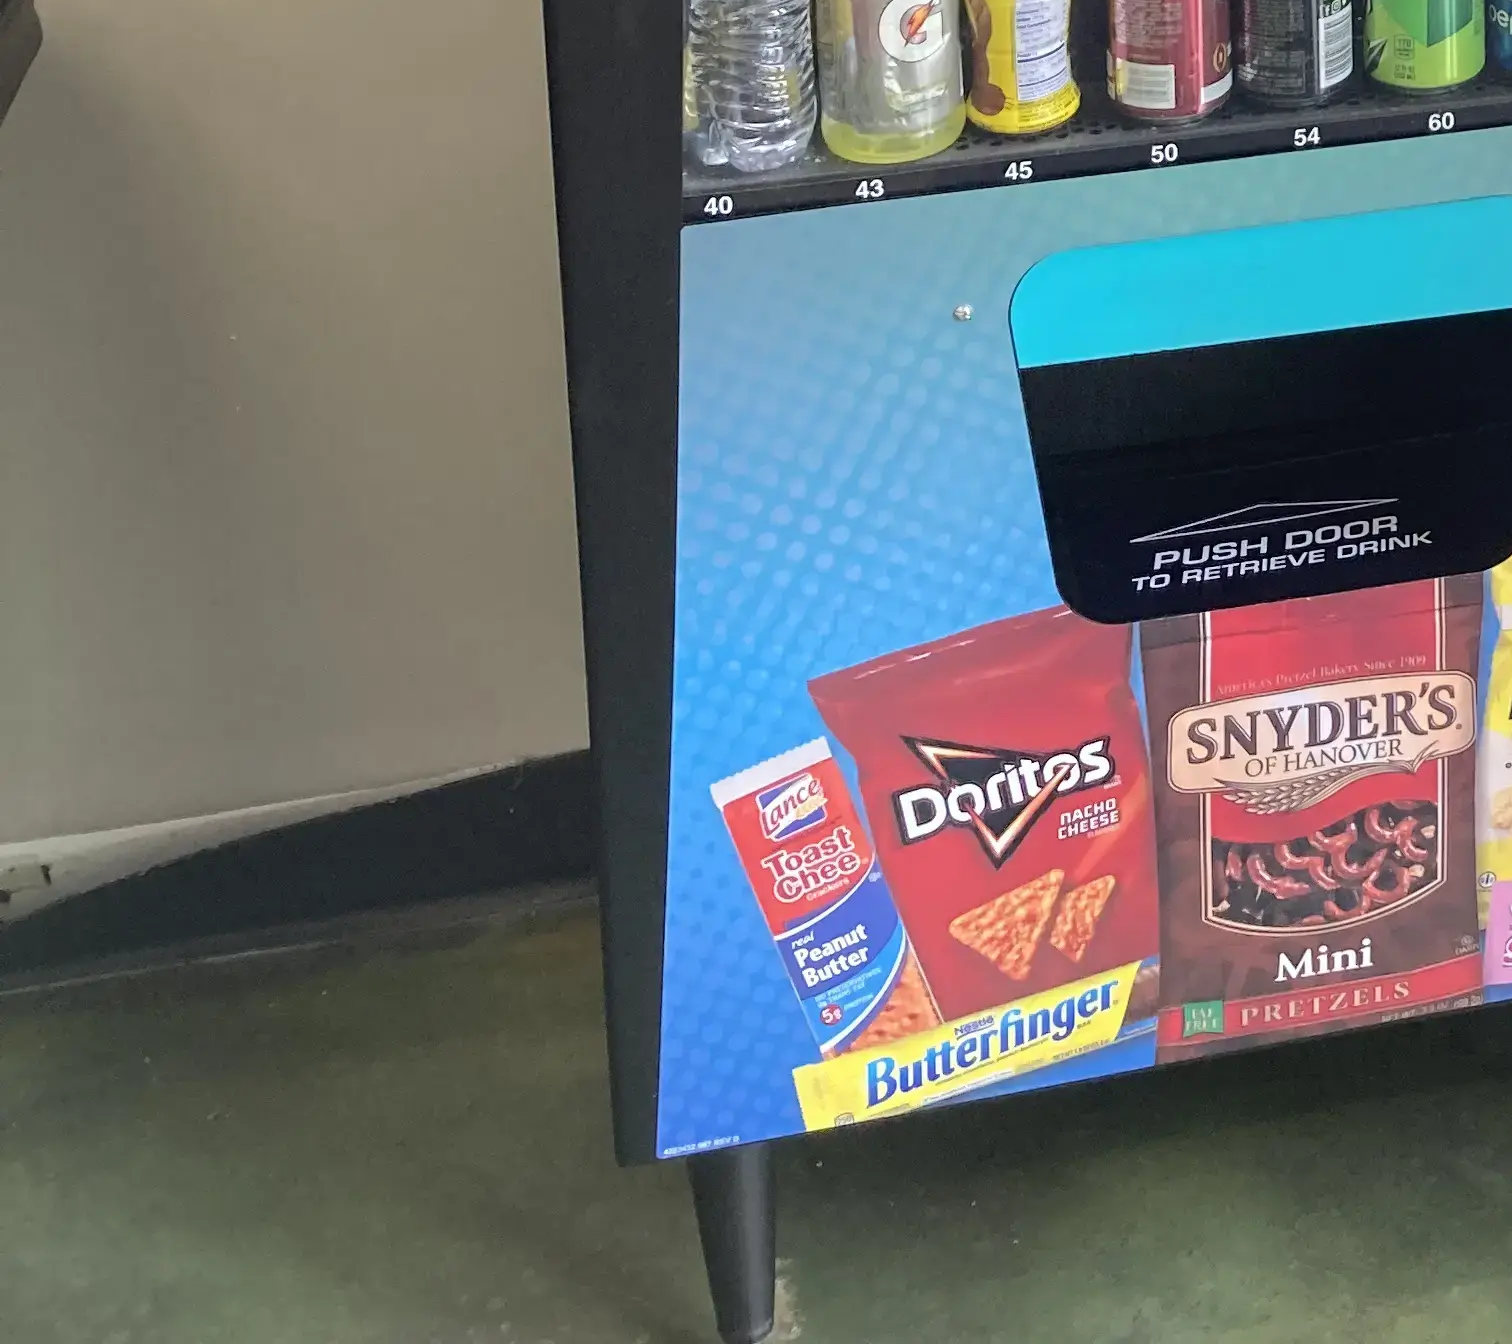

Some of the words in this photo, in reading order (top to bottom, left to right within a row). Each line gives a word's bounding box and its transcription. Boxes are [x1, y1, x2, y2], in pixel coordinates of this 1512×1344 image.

[1293, 126, 1321, 147] 54
[1428, 111, 1455, 132] 60
[1004, 160, 1034, 181] 45
[1151, 143, 1179, 163] 50
[704, 194, 734, 216] 40
[855, 178, 885, 200] 43
[1131, 573, 1171, 592] TO
[1181, 548, 1326, 585] RETRIEVE
[1336, 530, 1433, 560] DRINK
[1153, 536, 1269, 571] PUSH
[1284, 515, 1398, 551] DOOR
[1186, 681, 1458, 765] SNYDER'S
[1244, 756, 1277, 778] OF
[1283, 738, 1404, 773] HANOVER
[761, 777, 822, 837] Lance
[899, 739, 1111, 840] Doritos
[1059, 797, 1117, 826] NACHO
[1057, 810, 1119, 841] CHEESE
[763, 827, 853, 878] Toast
[775, 853, 860, 902] Chee
[791, 929, 815, 950] real
[794, 923, 868, 968] Peanut
[1273, 936, 1374, 983] Mini
[801, 946, 869, 989] Butter
[1240, 980, 1411, 1027] PRETZELS
[866, 979, 1119, 1109] Butterfinger
